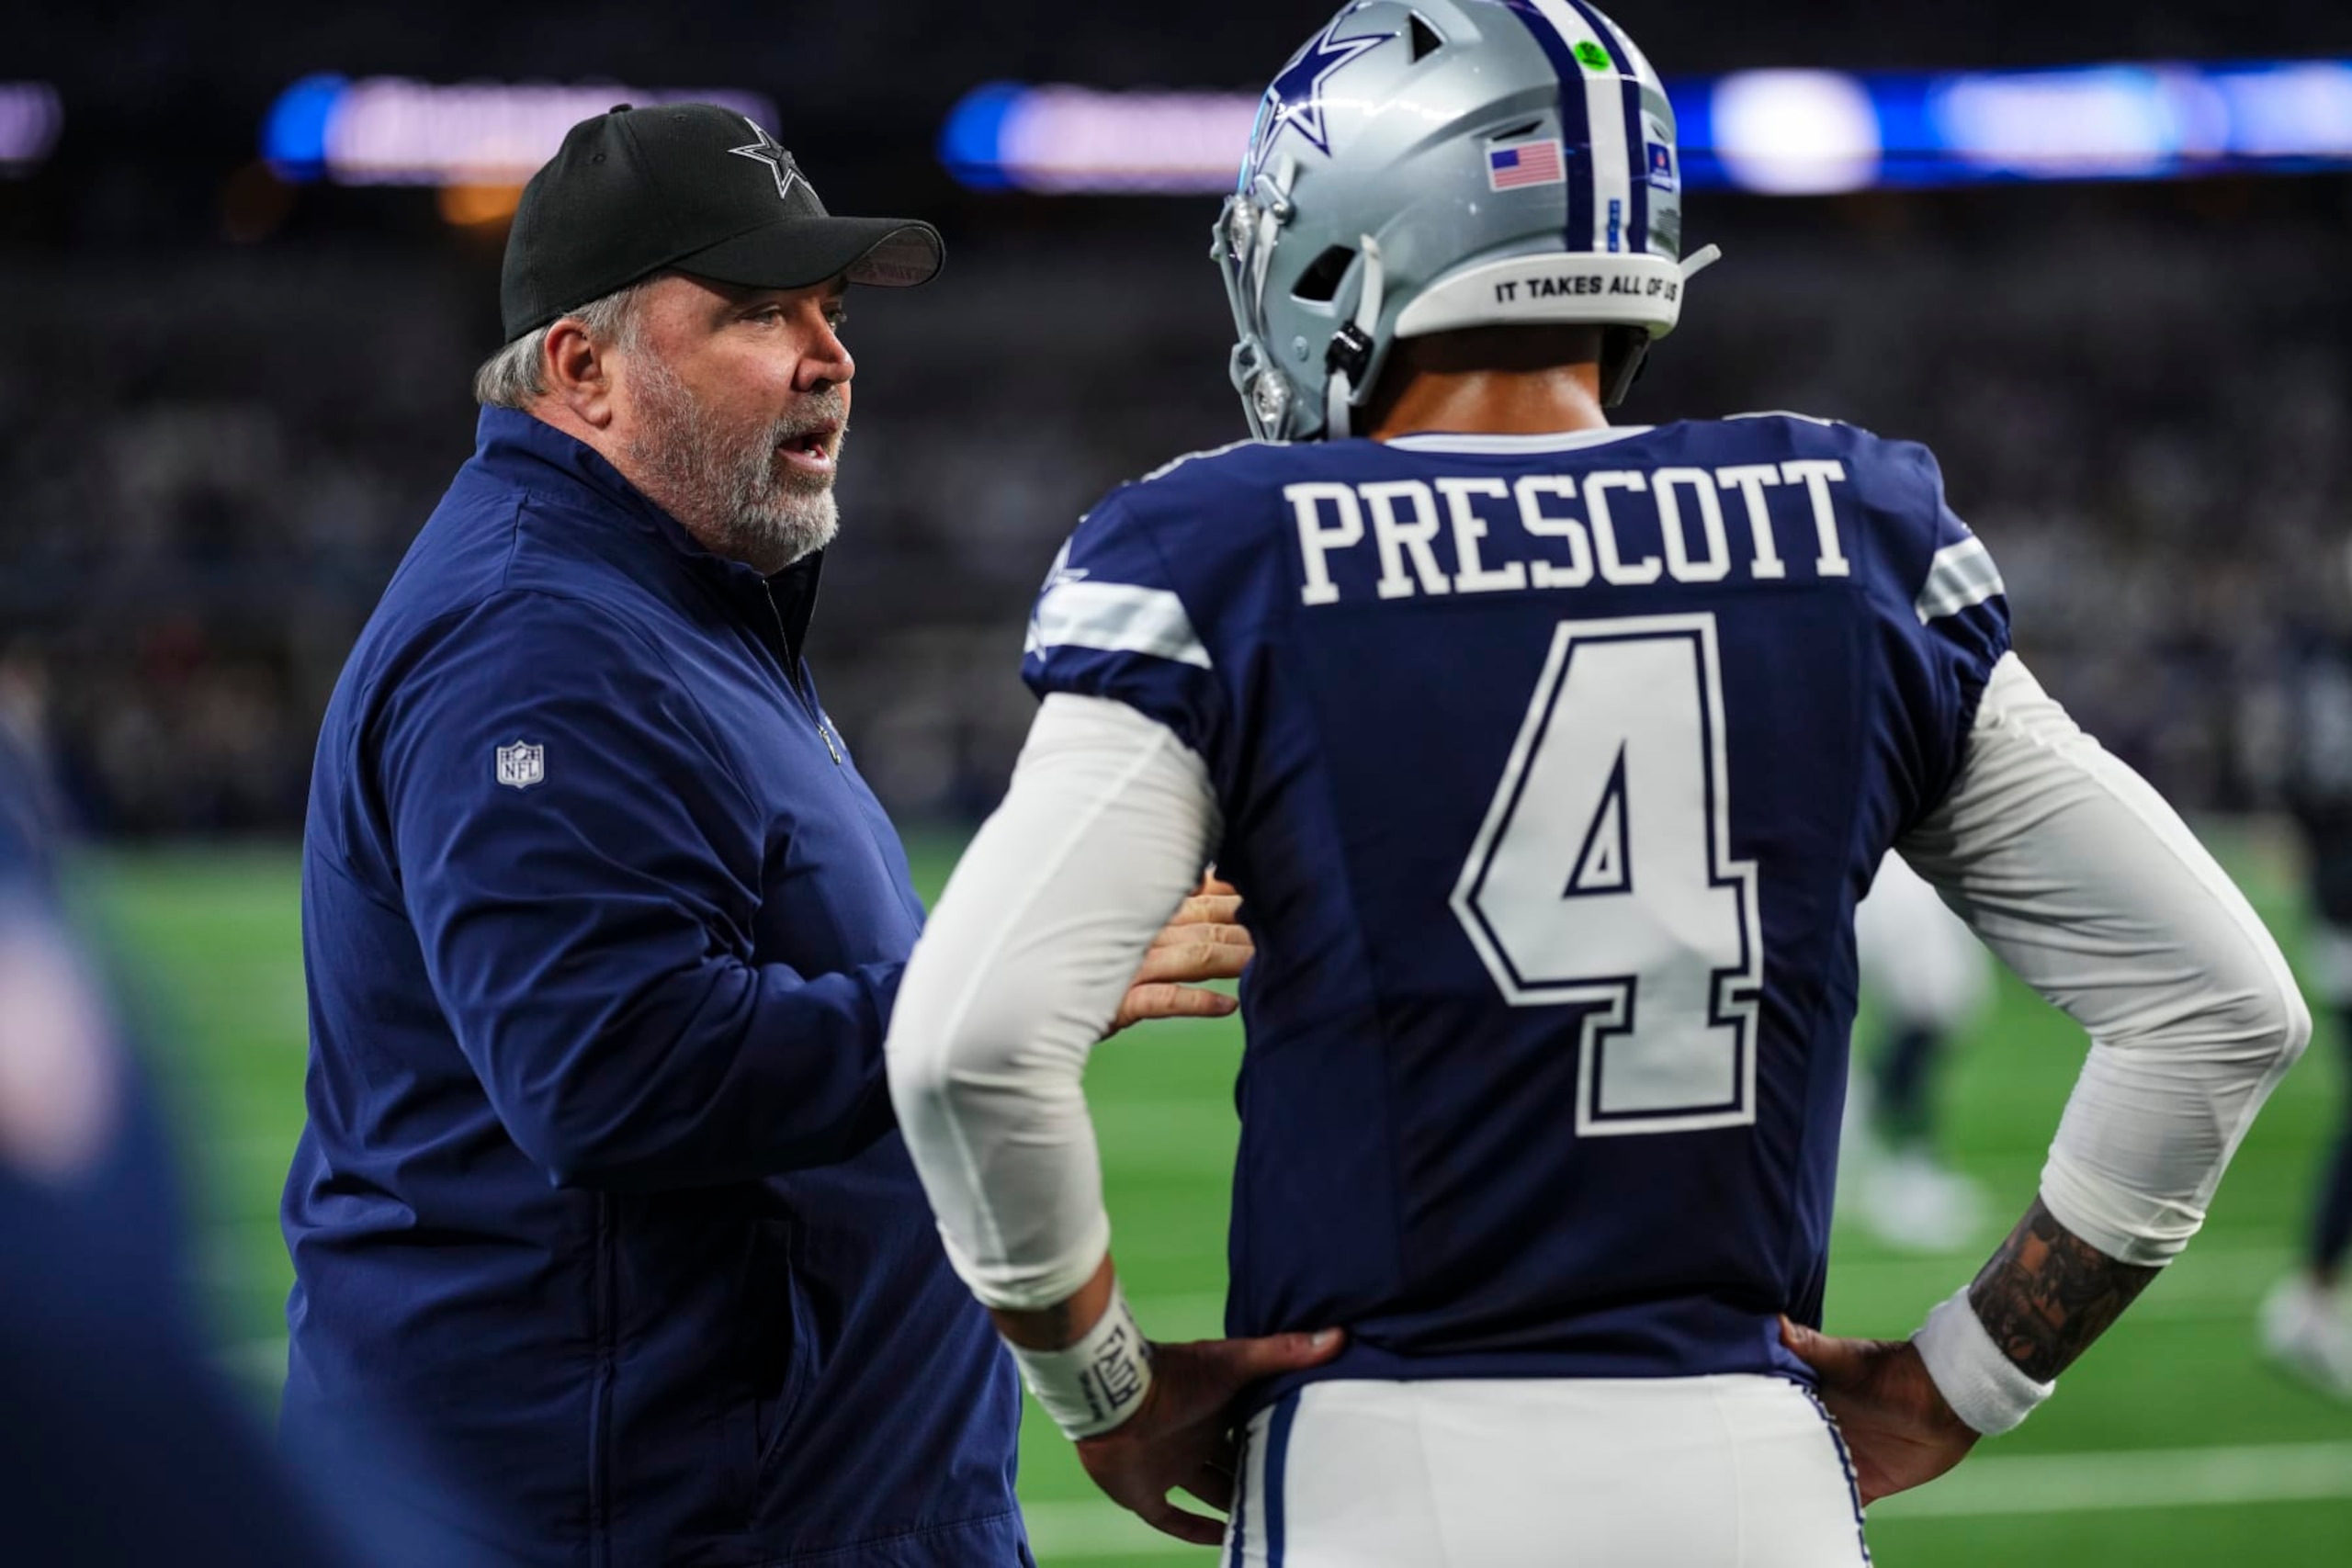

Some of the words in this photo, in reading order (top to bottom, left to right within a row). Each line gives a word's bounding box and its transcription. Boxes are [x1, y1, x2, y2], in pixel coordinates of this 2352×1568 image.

[1495, 281, 1518, 303] IT
[1526, 276, 1603, 299] TAKES
[1609, 276, 1642, 296] ALL
[1646, 277, 1664, 297] OF
[1283, 459, 1850, 606] PRESCOTT
[504, 761, 537, 780] NFL
[1449, 612, 1763, 1137] 4
